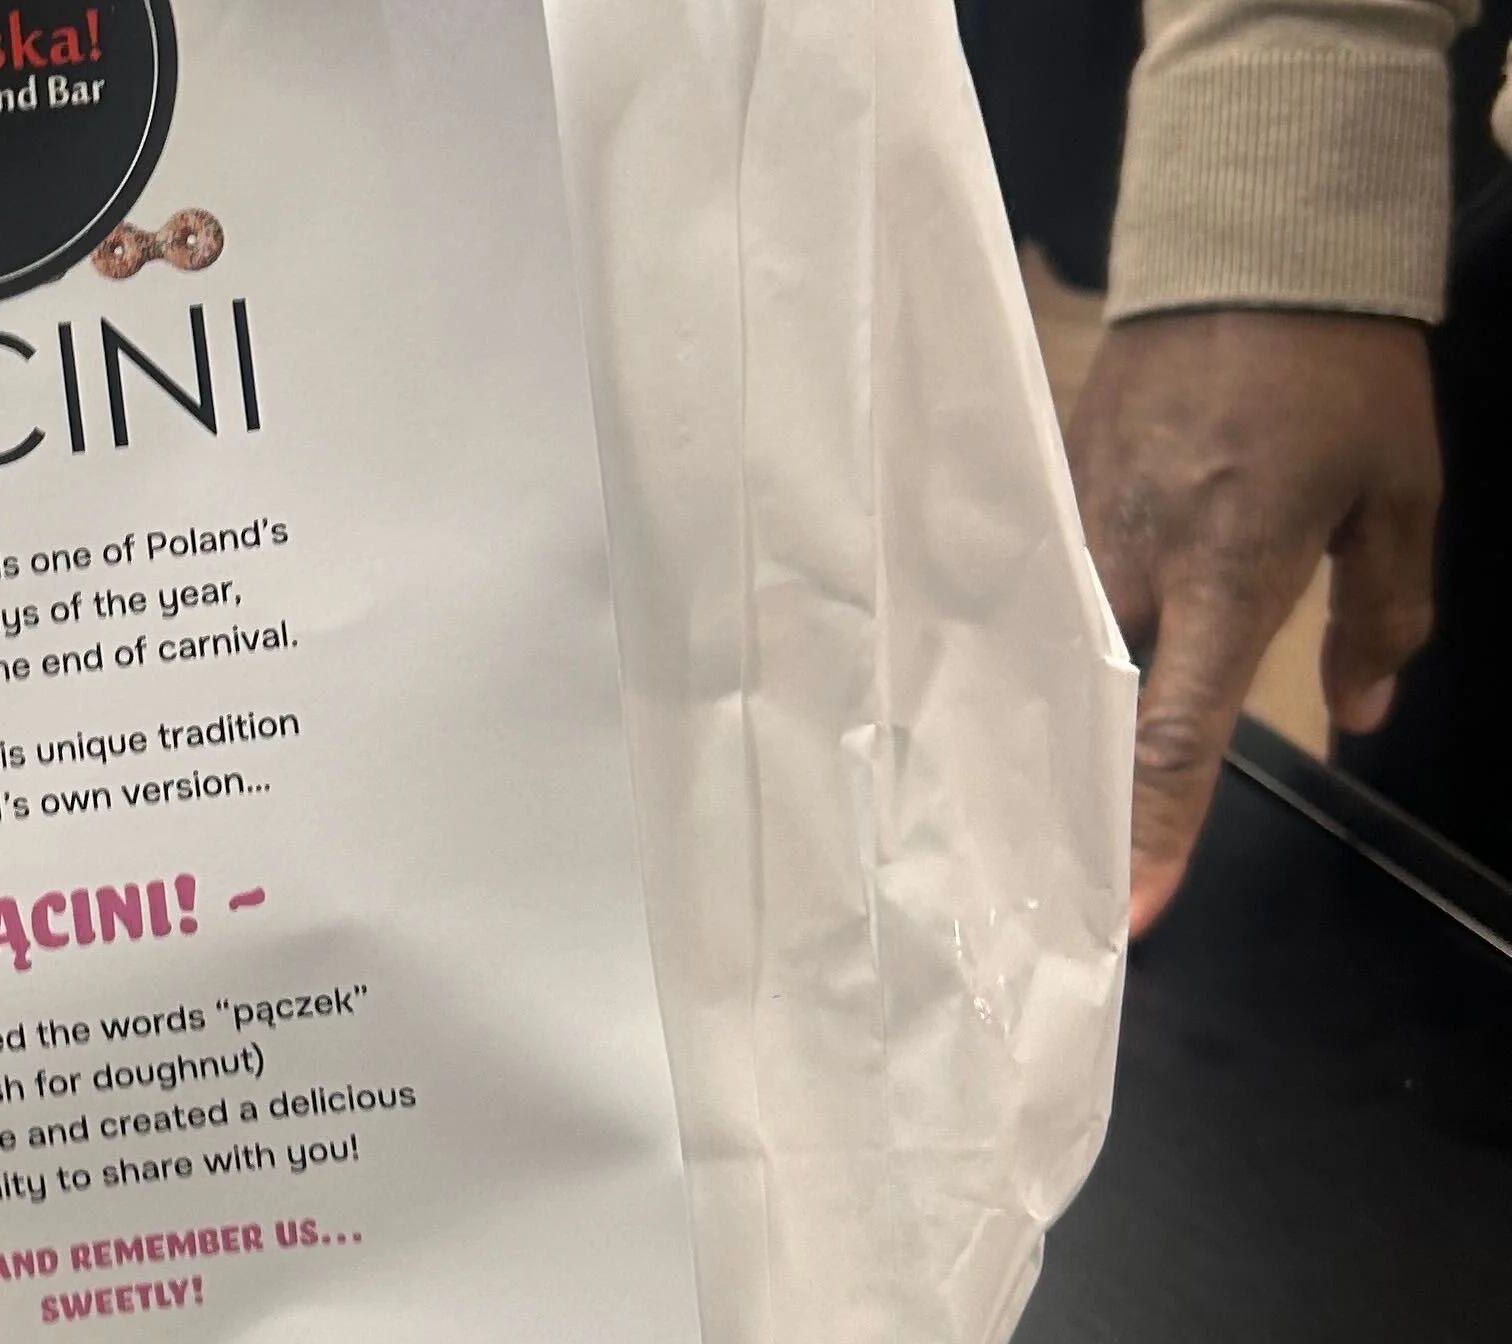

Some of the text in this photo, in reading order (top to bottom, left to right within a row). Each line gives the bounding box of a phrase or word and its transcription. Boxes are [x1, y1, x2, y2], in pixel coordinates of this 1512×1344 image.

[48, 74, 105, 108] Bar
[31, 547, 91, 576] one
[103, 533, 135, 566] of
[147, 517, 288, 562] Poland’s
[51, 591, 82, 624] of
[93, 589, 147, 620] the
[159, 580, 241, 620] year,
[42, 642, 103, 677] end
[115, 635, 147, 668] of
[159, 619, 297, 663] carnival.
[37, 731, 147, 766] unique
[158, 712, 299, 752] tradition
[41, 788, 111, 817] own
[121, 770, 270, 807] version...
[36, 1019, 90, 1049] the
[100, 1004, 205, 1041] words
[216, 985, 367, 1033] “pączek”
[35, 1069, 81, 1100] for
[93, 1042, 264, 1092] doughnut)
[28, 1114, 89, 1149] and
[100, 1098, 228, 1140] created
[240, 1101, 258, 1123] a
[269, 1084, 416, 1120] delicious
[56, 1166, 91, 1193] to
[103, 1157, 192, 1187] share
[203, 1142, 275, 1175] with
[287, 1133, 359, 1175] you!
[71, 1224, 263, 1272] REMEMBER
[275, 1218, 362, 1249] US...
[41, 1275, 203, 1324] SWEETLY!
